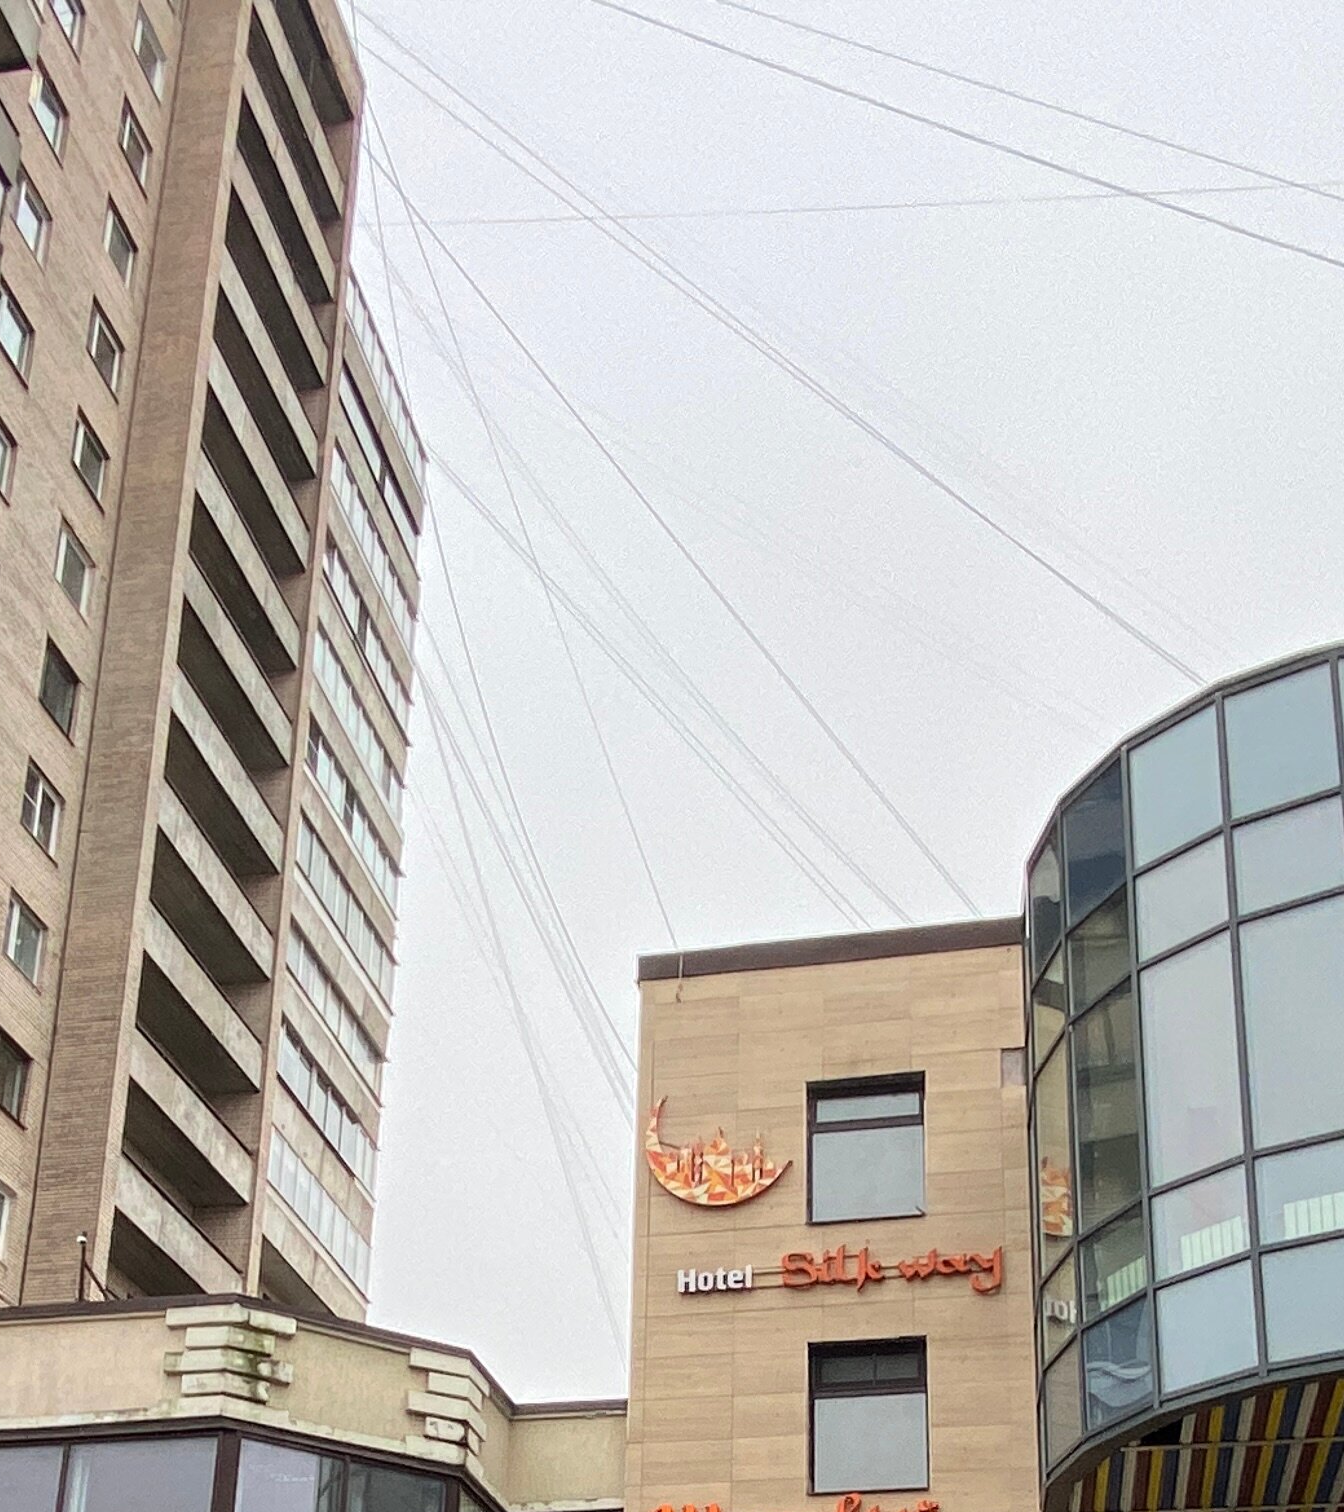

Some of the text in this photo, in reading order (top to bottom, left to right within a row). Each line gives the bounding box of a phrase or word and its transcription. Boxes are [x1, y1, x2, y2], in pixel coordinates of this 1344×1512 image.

[676, 1244, 1004, 1294] Hotel Silk way
